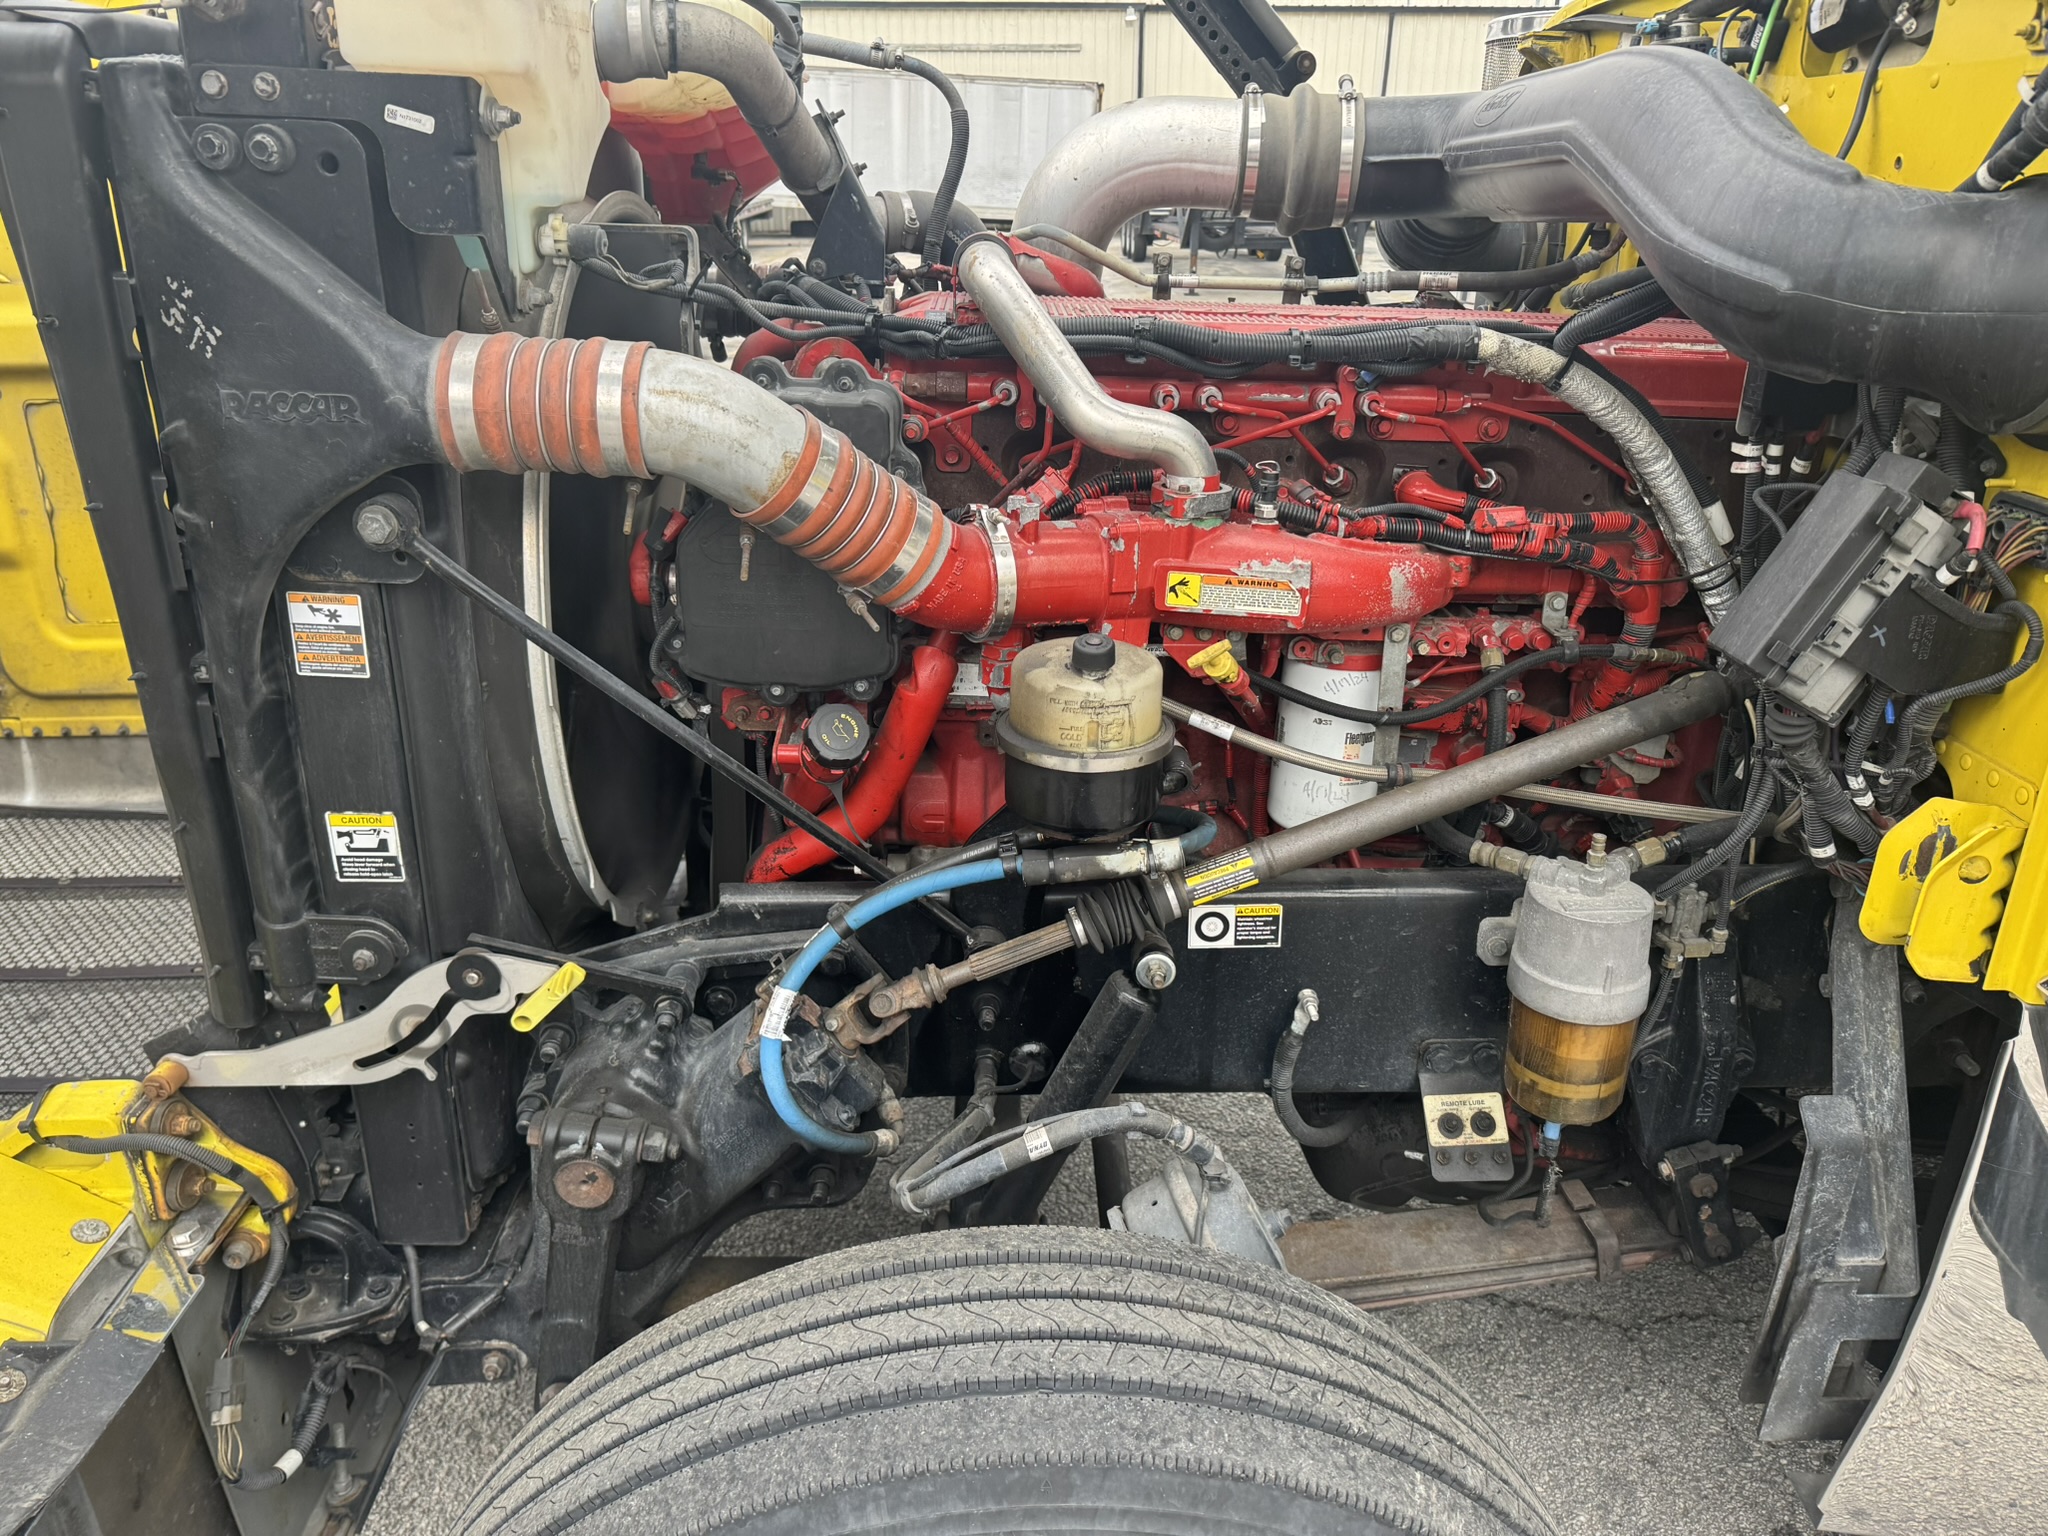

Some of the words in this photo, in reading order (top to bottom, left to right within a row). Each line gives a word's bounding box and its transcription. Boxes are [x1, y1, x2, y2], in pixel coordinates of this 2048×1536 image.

[217, 387, 366, 425] PACCAR
[1237, 578, 1279, 588] WARNING
[310, 595, 345, 604] WARNING
[306, 633, 360, 642] AVERTISSEMENT
[312, 654, 360, 662] ADVERTENCIA
[841, 713, 859, 738] ENGINE
[821, 733, 830, 746] OIL
[1060, 732, 1082, 741] COLD
[1344, 731, 1376, 746] Fleetguar
[340, 816, 382, 824] CAUTION
[962, 844, 996, 859] DYNACRAFT
[1440, 1099, 1468, 1107] REMOTE
